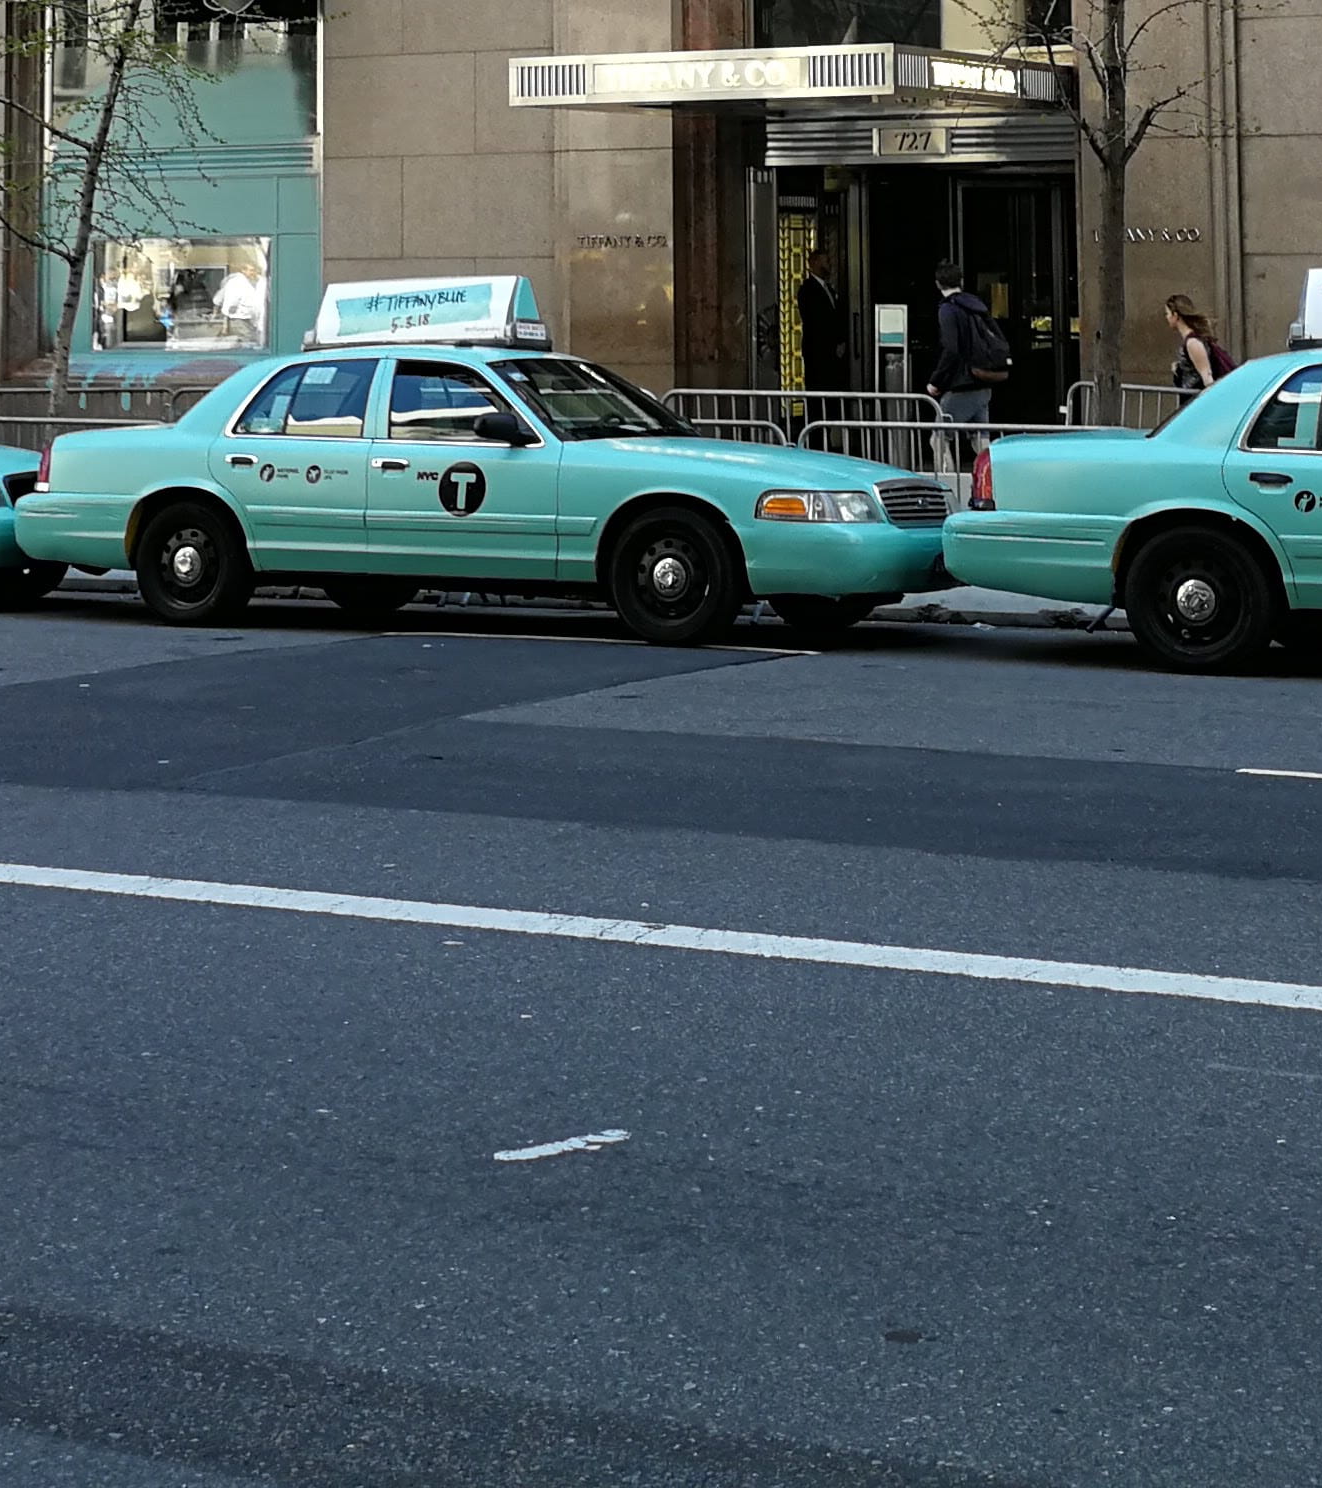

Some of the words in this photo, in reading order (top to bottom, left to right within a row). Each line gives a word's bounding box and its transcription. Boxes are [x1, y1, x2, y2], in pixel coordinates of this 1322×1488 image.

[894, 131, 932, 152] 727
[577, 234, 632, 249] TIFFANY
[415, 470, 439, 481] NYC
[449, 472, 477, 510] T
